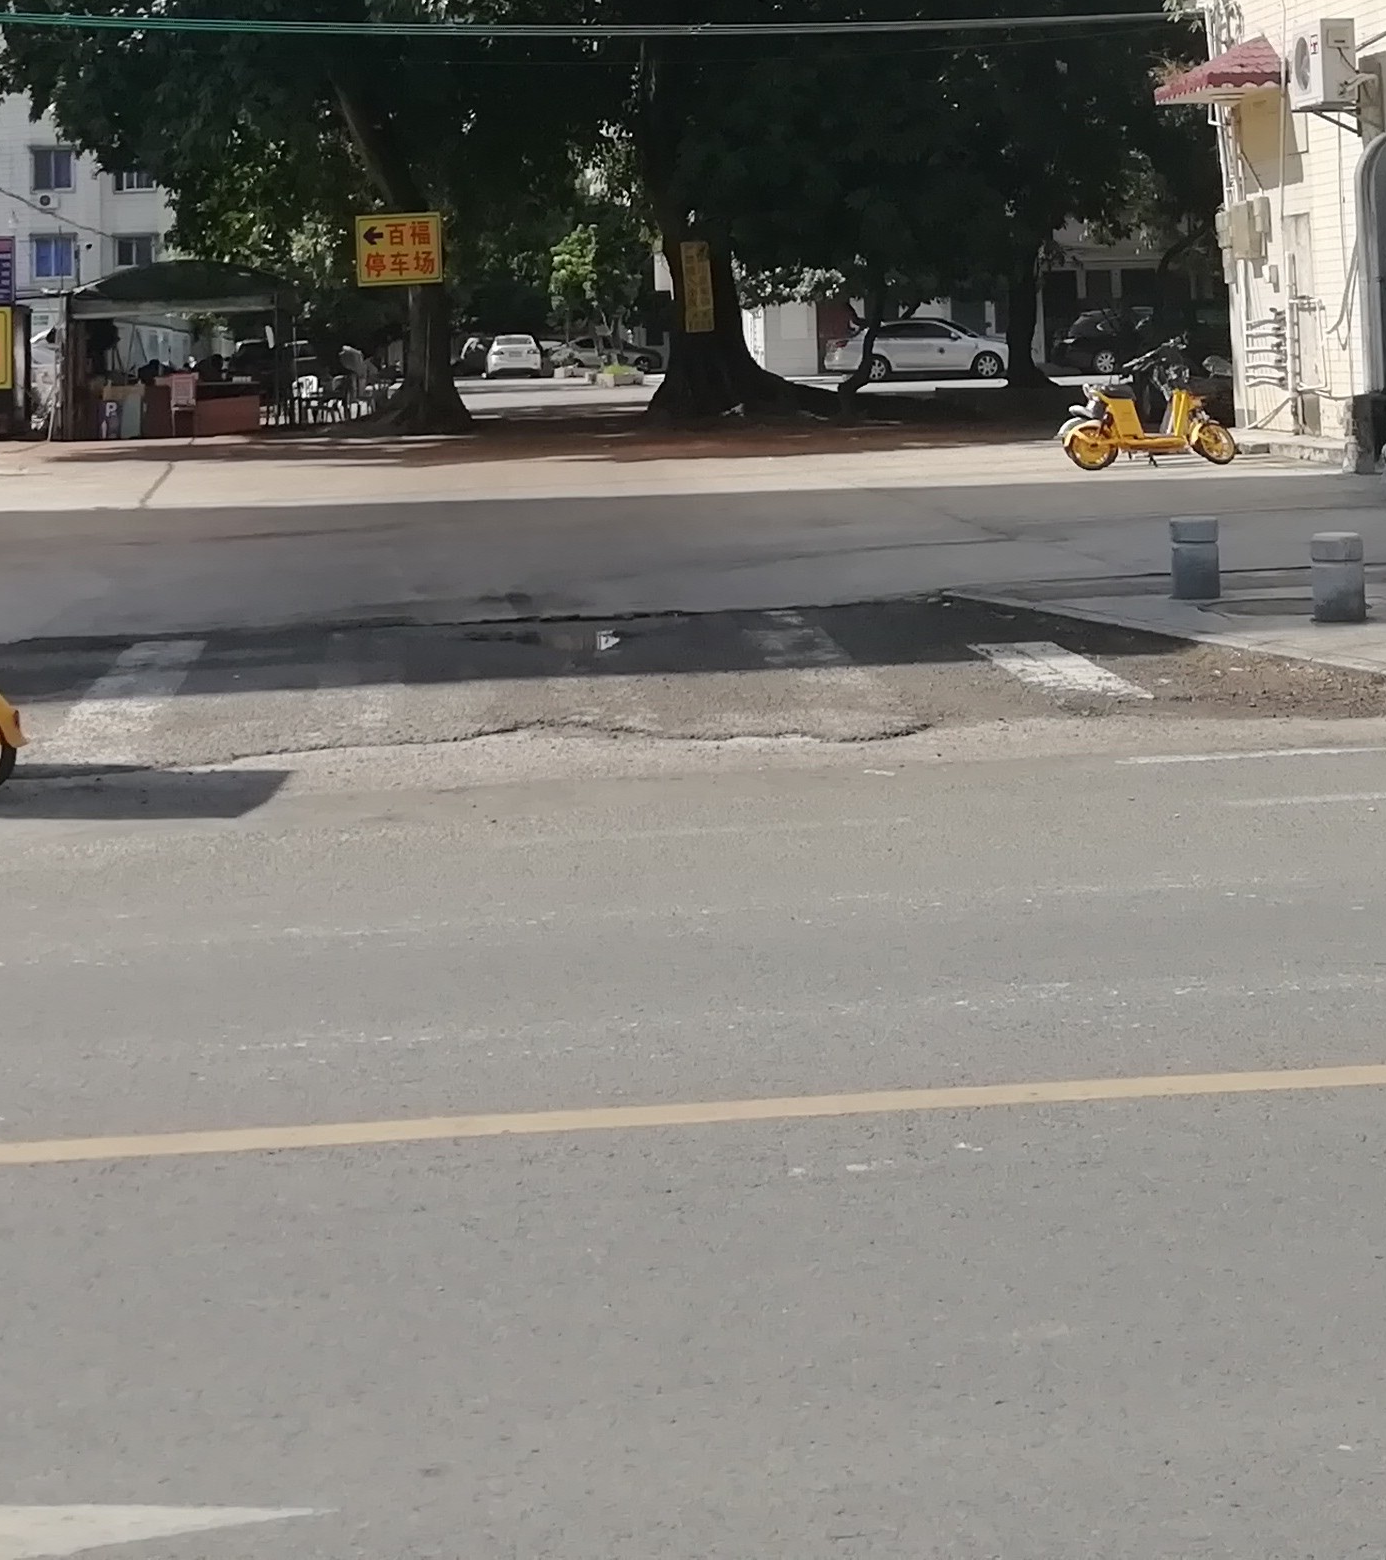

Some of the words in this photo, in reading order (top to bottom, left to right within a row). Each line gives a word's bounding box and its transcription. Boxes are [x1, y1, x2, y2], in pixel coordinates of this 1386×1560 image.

[385, 221, 431, 246] 百福
[365, 251, 435, 278] 停车场
